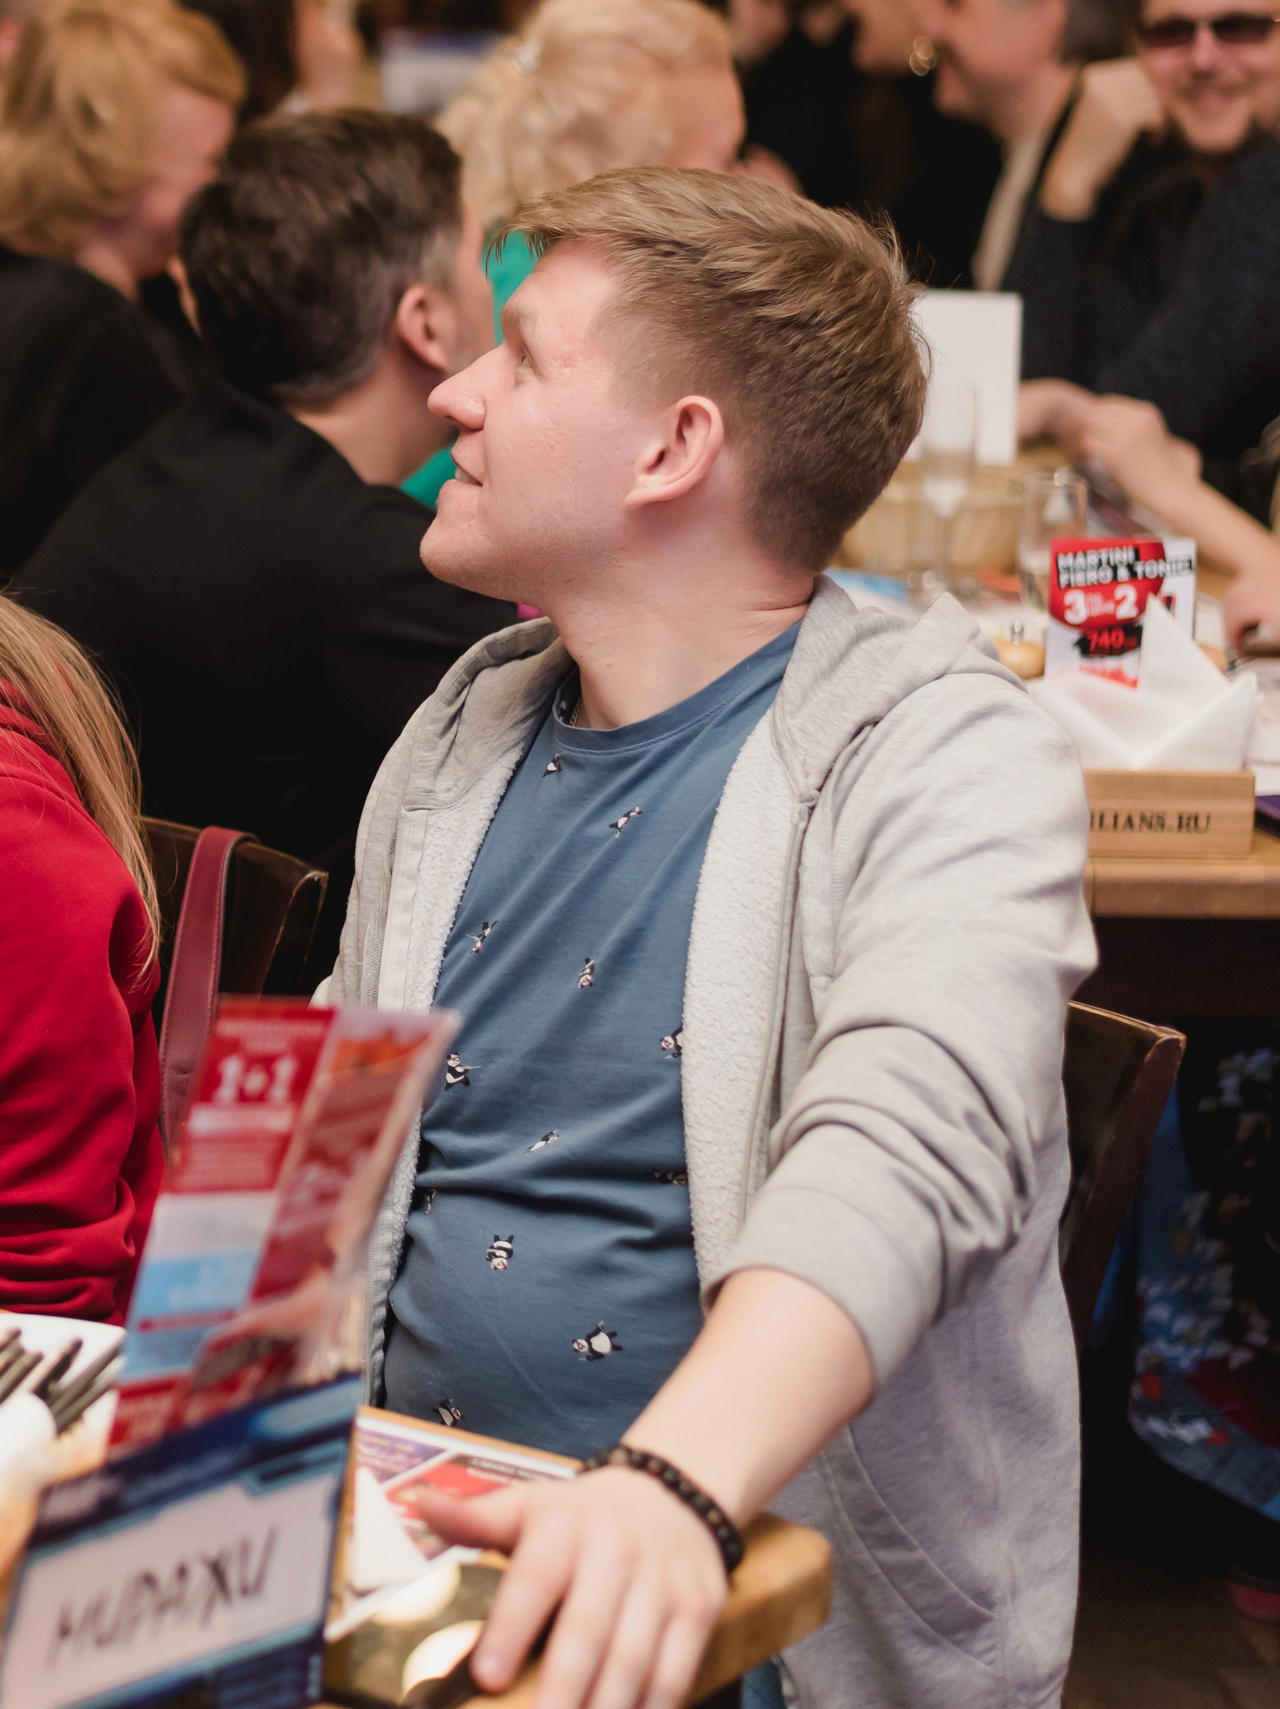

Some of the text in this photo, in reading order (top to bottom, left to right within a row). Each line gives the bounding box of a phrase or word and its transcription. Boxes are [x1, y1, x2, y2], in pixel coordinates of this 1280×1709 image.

[1058, 546, 1135, 568] MARTINI
[1059, 566, 1114, 588] FIERO
[1133, 559, 1192, 579] TONIC
[1063, 588, 1088, 625] 3
[1114, 583, 1139, 620] 2
[1087, 627, 1124, 651] 740
